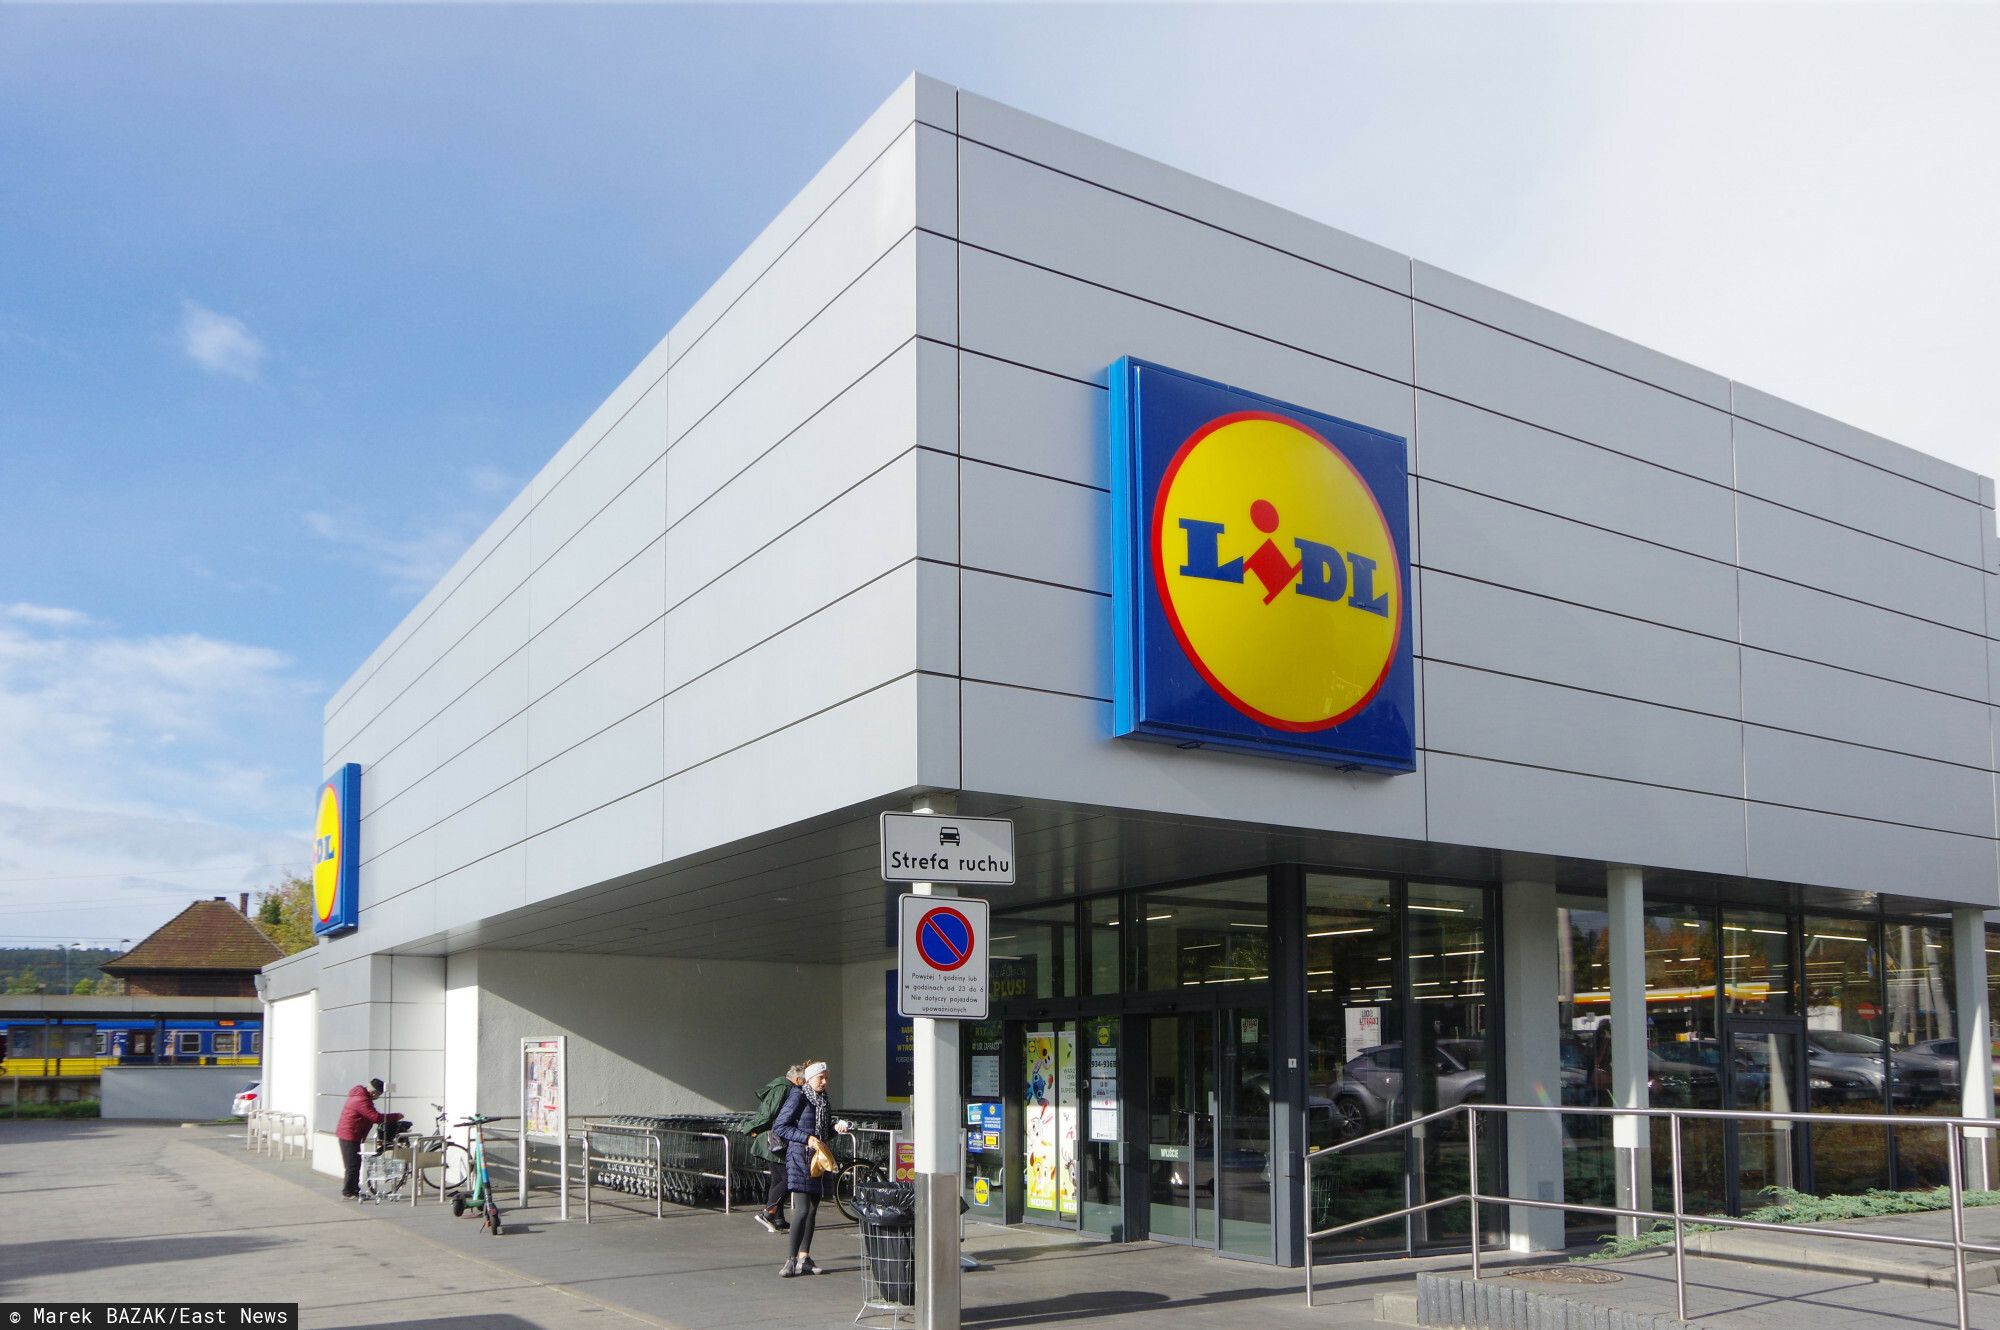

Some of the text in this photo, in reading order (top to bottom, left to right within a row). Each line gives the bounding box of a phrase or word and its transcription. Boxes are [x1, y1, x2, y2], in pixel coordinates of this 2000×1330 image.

[1179, 499, 1389, 618] LIDL
[891, 851, 1009, 872] Strefa ruchu
[943, 975, 965, 983] godziny
[924, 995, 947, 1003] dotyczy
